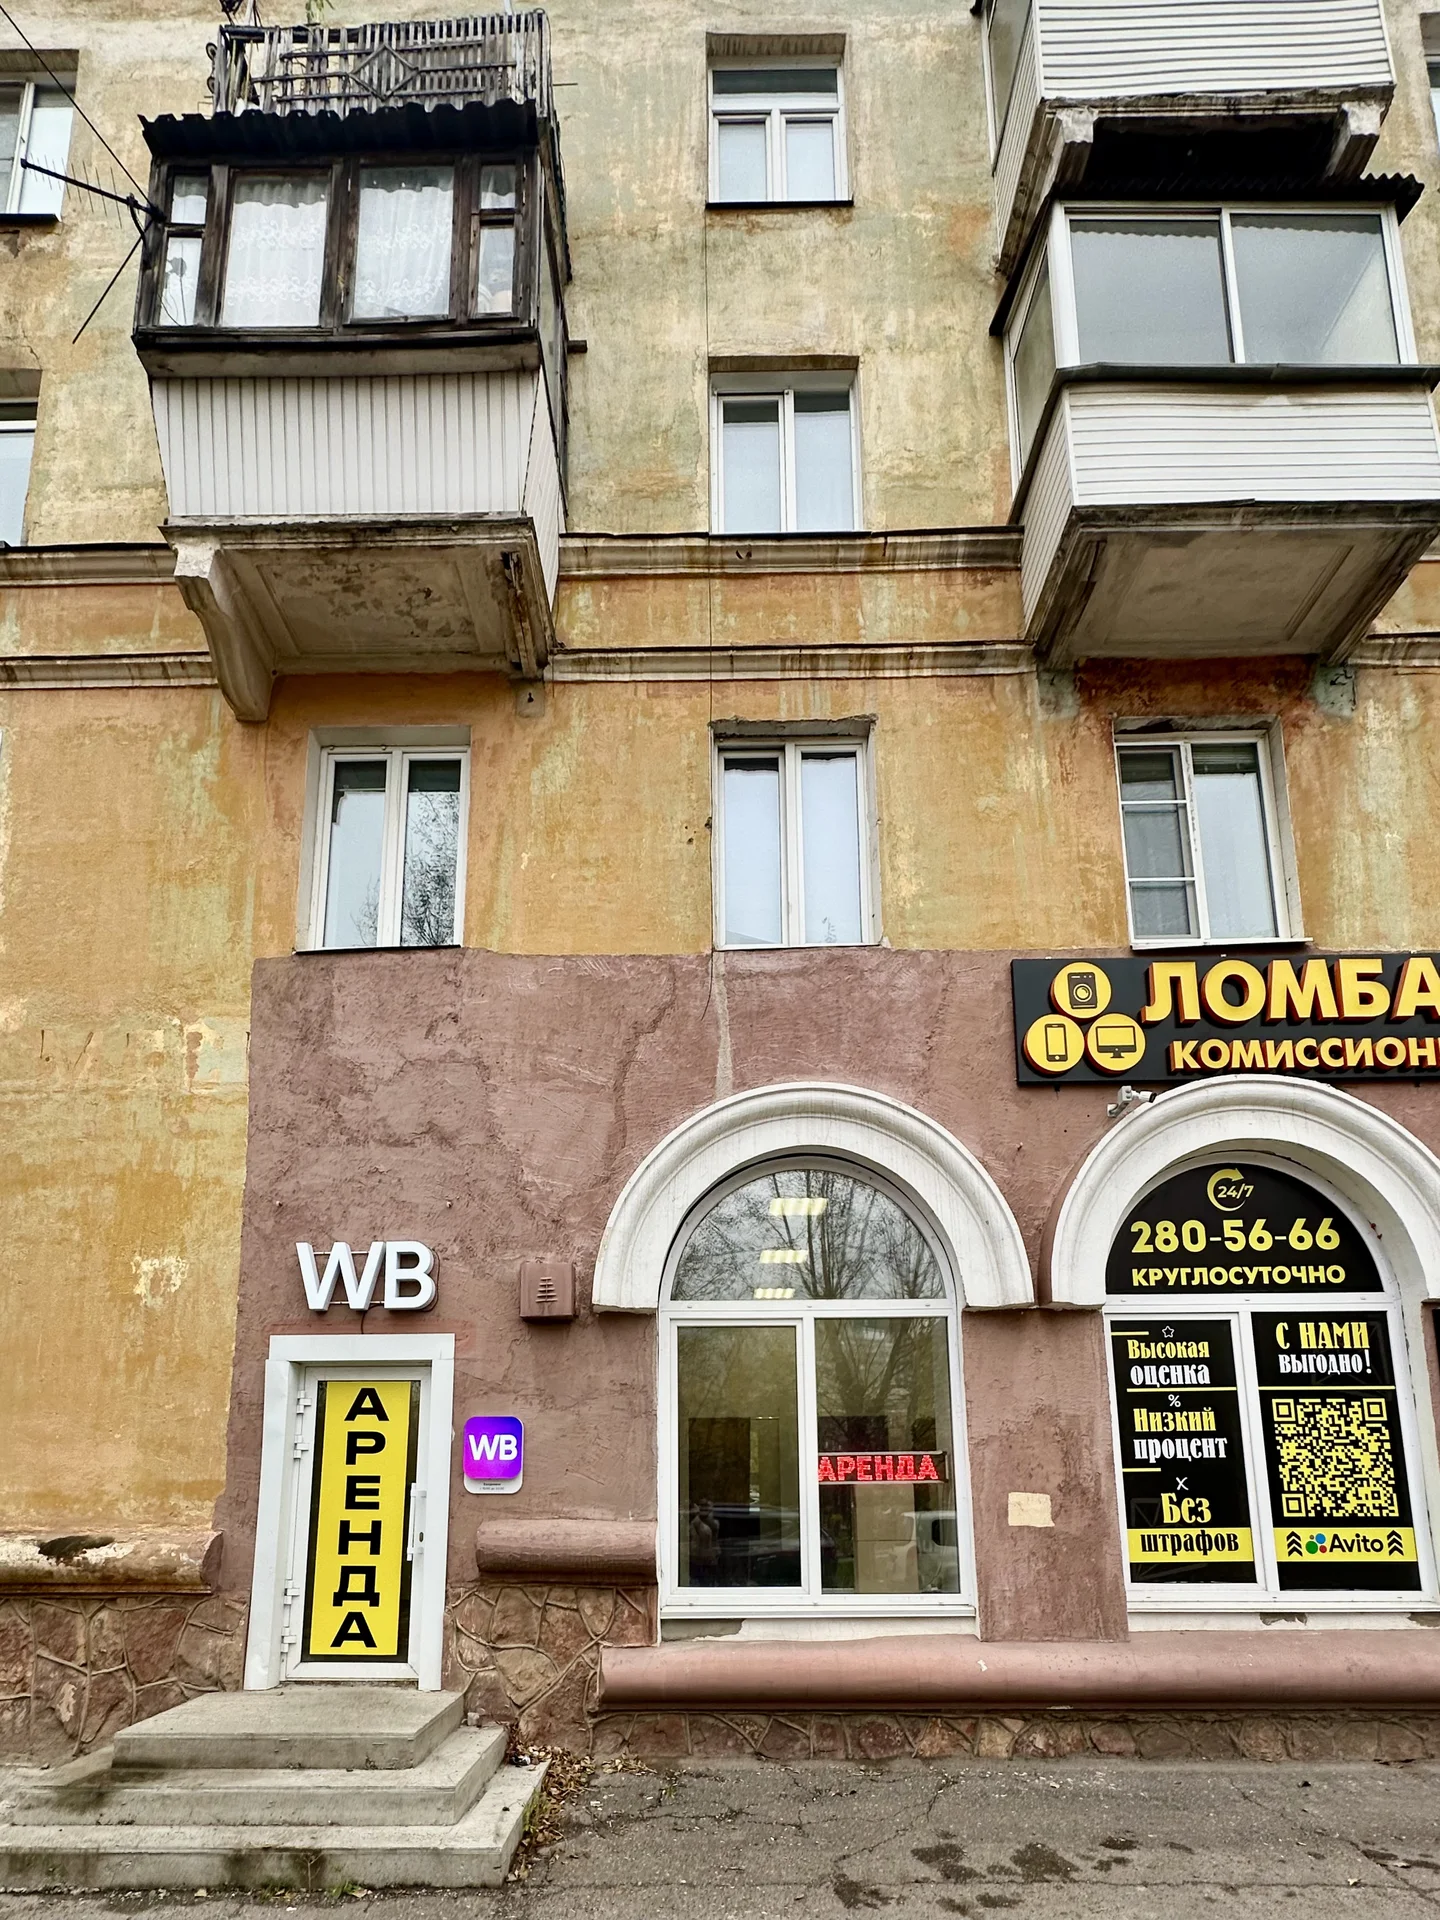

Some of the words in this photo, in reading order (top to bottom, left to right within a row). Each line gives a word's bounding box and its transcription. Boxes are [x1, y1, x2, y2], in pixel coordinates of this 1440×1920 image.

[1141, 956, 1440, 1024] ЛОМБА
[1170, 1036, 1440, 1073] КОМИССИОН
[1217, 1184, 1254, 1199] 24/7
[1130, 1217, 1341, 1254] 280-56-66
[295, 1240, 436, 1311] WB
[1131, 1264, 1346, 1287] КРУГЛОСУТОЧНО
[1126, 1339, 1211, 1359] Высокая
[1275, 1321, 1290, 1350] С
[1298, 1321, 1370, 1349] НАМИ
[1130, 1364, 1211, 1388] оценка
[1278, 1349, 1372, 1376] выгодно!
[1133, 1406, 1216, 1432] Низкий
[468, 1434, 518, 1461] WB
[1133, 1437, 1228, 1464] процент
[818, 1454, 939, 1482] АРЕНДА
[330, 1387, 390, 1648] АРЕНДА
[1160, 1492, 1212, 1524] Без
[1140, 1530, 1240, 1556] штрафов
[1329, 1533, 1384, 1553] Avito
